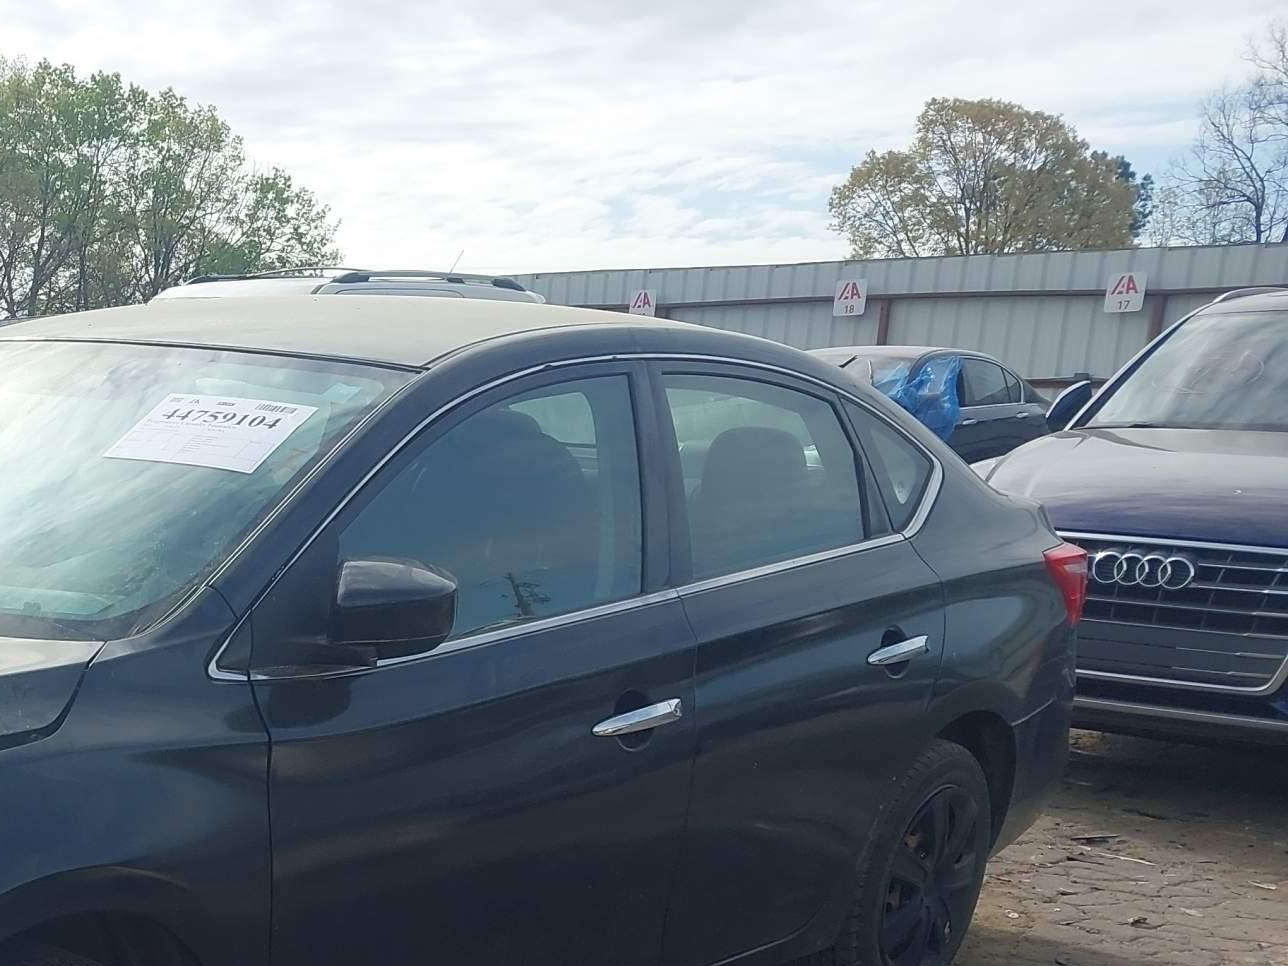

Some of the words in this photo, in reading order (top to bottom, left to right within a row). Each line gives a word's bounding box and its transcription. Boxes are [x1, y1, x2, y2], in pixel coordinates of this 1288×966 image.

[844, 304, 855, 313] 18
[1118, 300, 1130, 310] 17
[162, 408, 282, 430] 44759104
